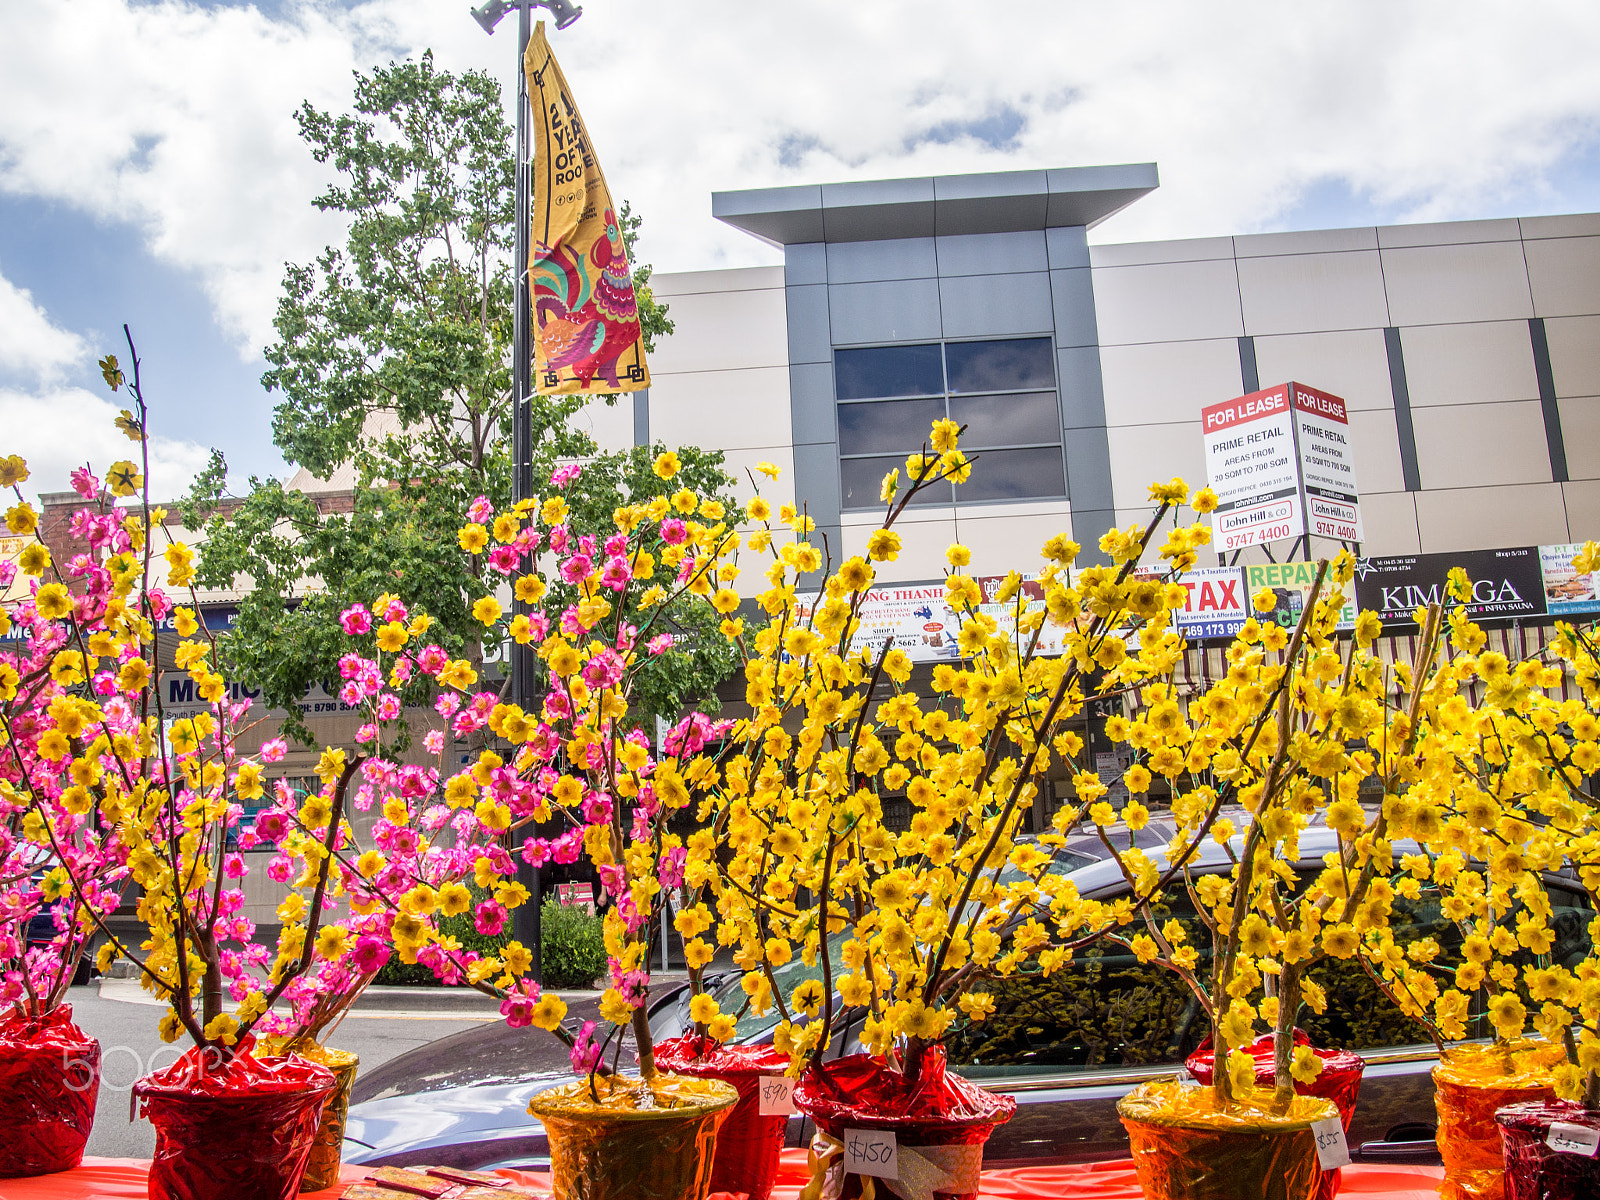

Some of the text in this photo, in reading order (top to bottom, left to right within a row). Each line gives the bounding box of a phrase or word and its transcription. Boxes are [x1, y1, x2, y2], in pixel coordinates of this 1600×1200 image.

[555, 147, 575, 170] OF
[1207, 393, 1284, 428] FOR LEASE
[1297, 391, 1345, 419] FOR LEASE
[1212, 427, 1284, 454] PRIME RETAIL
[1302, 424, 1347, 445] PRIME RETAIL
[1224, 447, 1275, 467] AREAS FROM
[1311, 444, 1343, 458] AREAS FROM
[1215, 457, 1288, 482] 20 SQM TO 700 SQM
[1305, 455, 1312, 463] 20
[1312, 456, 1324, 466] SQM
[1324, 459, 1331, 468] TO
[1340, 463, 1351, 473] SQM
[1225, 507, 1287, 529] John Hill & CO
[1315, 503, 1330, 515] John
[1330, 507, 1341, 517] Hill
[1226, 524, 1290, 549] 9747 4400
[1316, 521, 1357, 540] 9747 4400
[893, 588, 943, 600] THANH
[1177, 579, 1240, 612] TAX
[1381, 584, 1440, 609] KIM
[1485, 604, 1507, 612] INFRA
[1508, 602, 1534, 610] SAUNA
[1206, 623, 1225, 635] 173
[899, 639, 916, 647] 5662
[314, 702, 337, 712] 9790
[763, 1081, 787, 1106] $90
[848, 1135, 892, 1163] $150
[1317, 1131, 1339, 1150] $55
